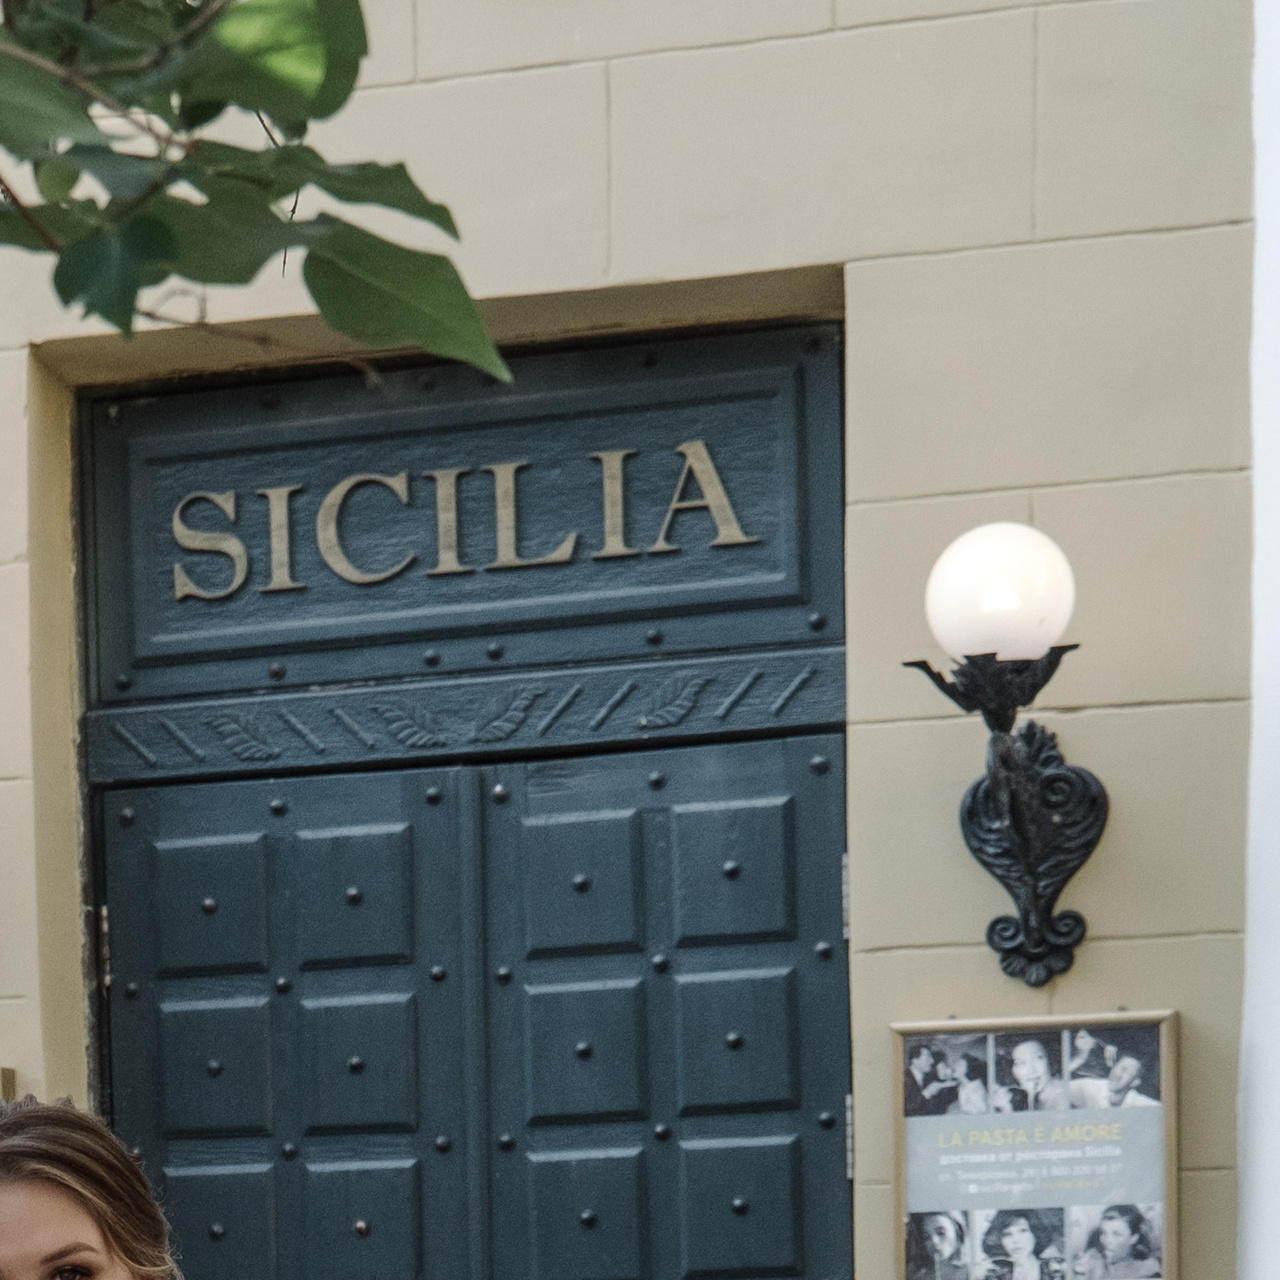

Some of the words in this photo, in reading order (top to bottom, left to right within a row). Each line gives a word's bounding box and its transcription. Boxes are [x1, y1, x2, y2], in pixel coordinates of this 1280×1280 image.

[171, 440, 760, 600] SICILIA
[938, 1132, 963, 1148] LA
[968, 1128, 1028, 1146] PASTA
[1050, 1123, 1122, 1142] AMORE
